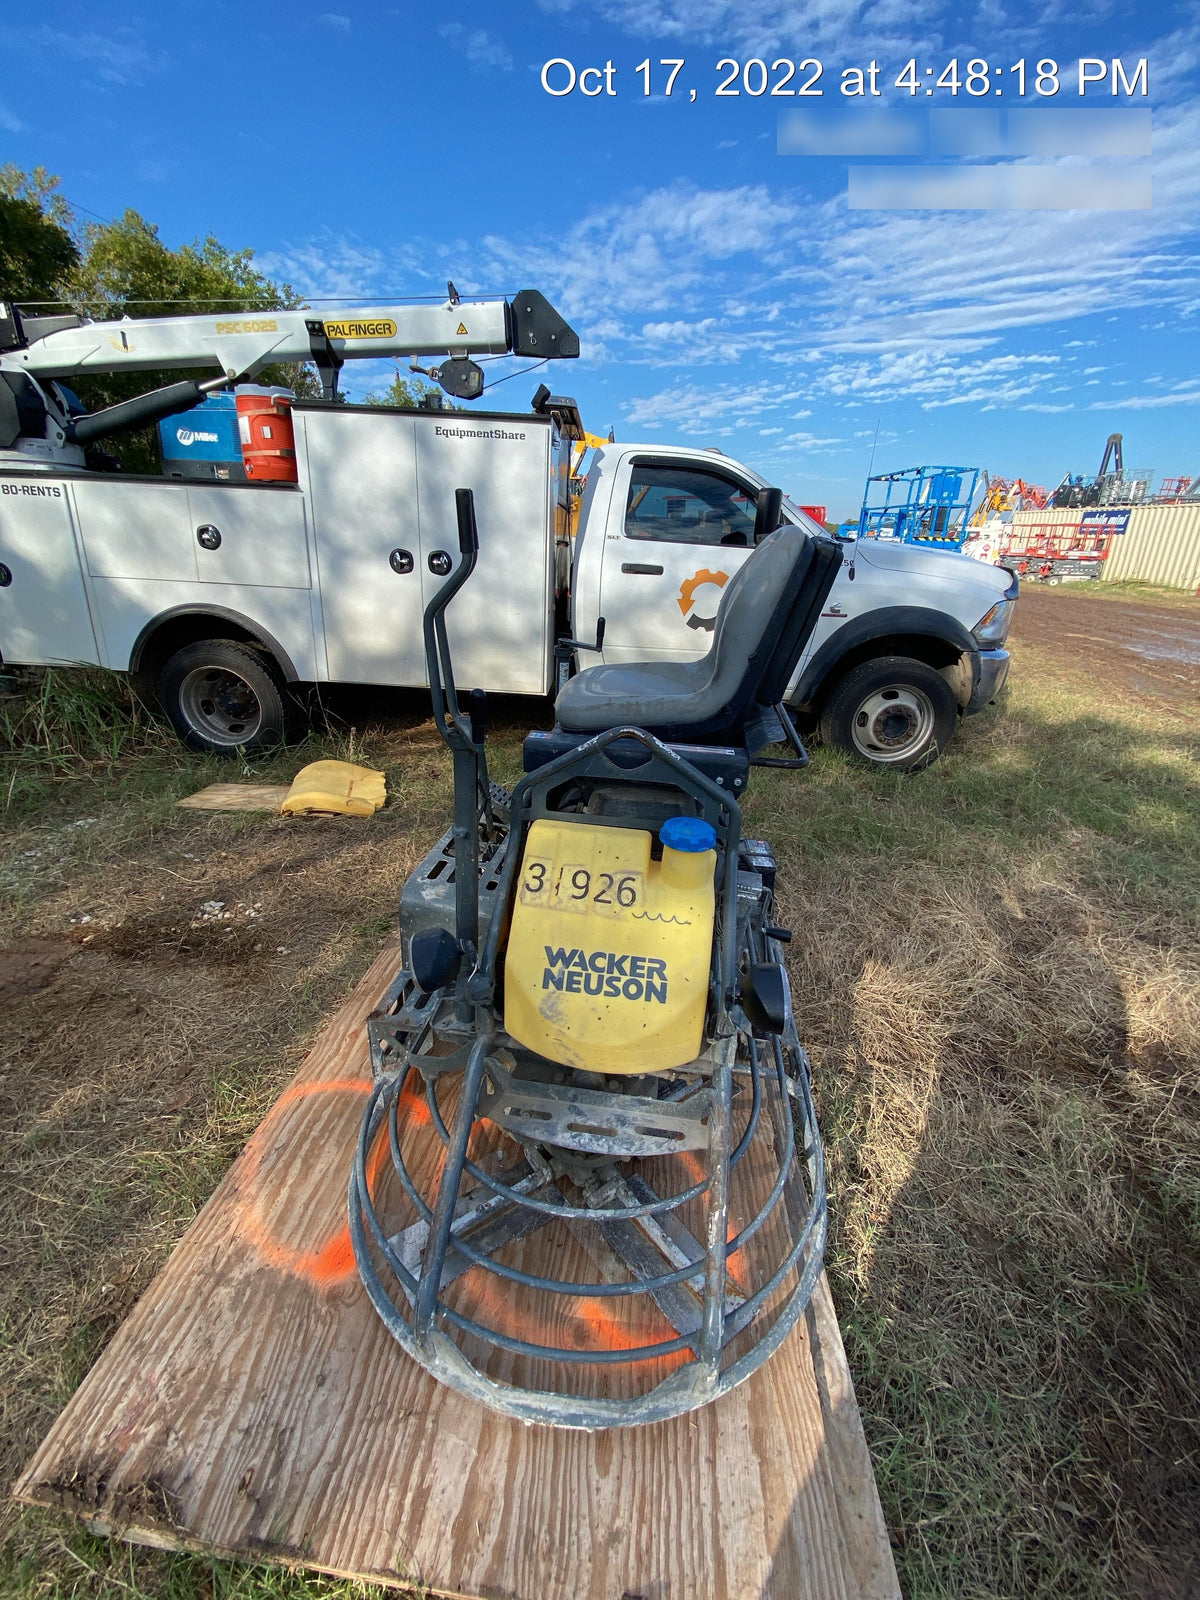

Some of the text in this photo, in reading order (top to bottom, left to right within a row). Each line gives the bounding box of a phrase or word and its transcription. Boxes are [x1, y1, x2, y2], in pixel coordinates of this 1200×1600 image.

[216, 320, 278, 334] PSC 6025
[327, 323, 392, 337] PALFINGER
[194, 431, 219, 442] Miller
[435, 426, 526, 440] EquipmentShare
[1, 484, 61, 497] 80-RENTS
[544, 946, 668, 981] WACKER
[542, 968, 668, 1004] NEUSON
